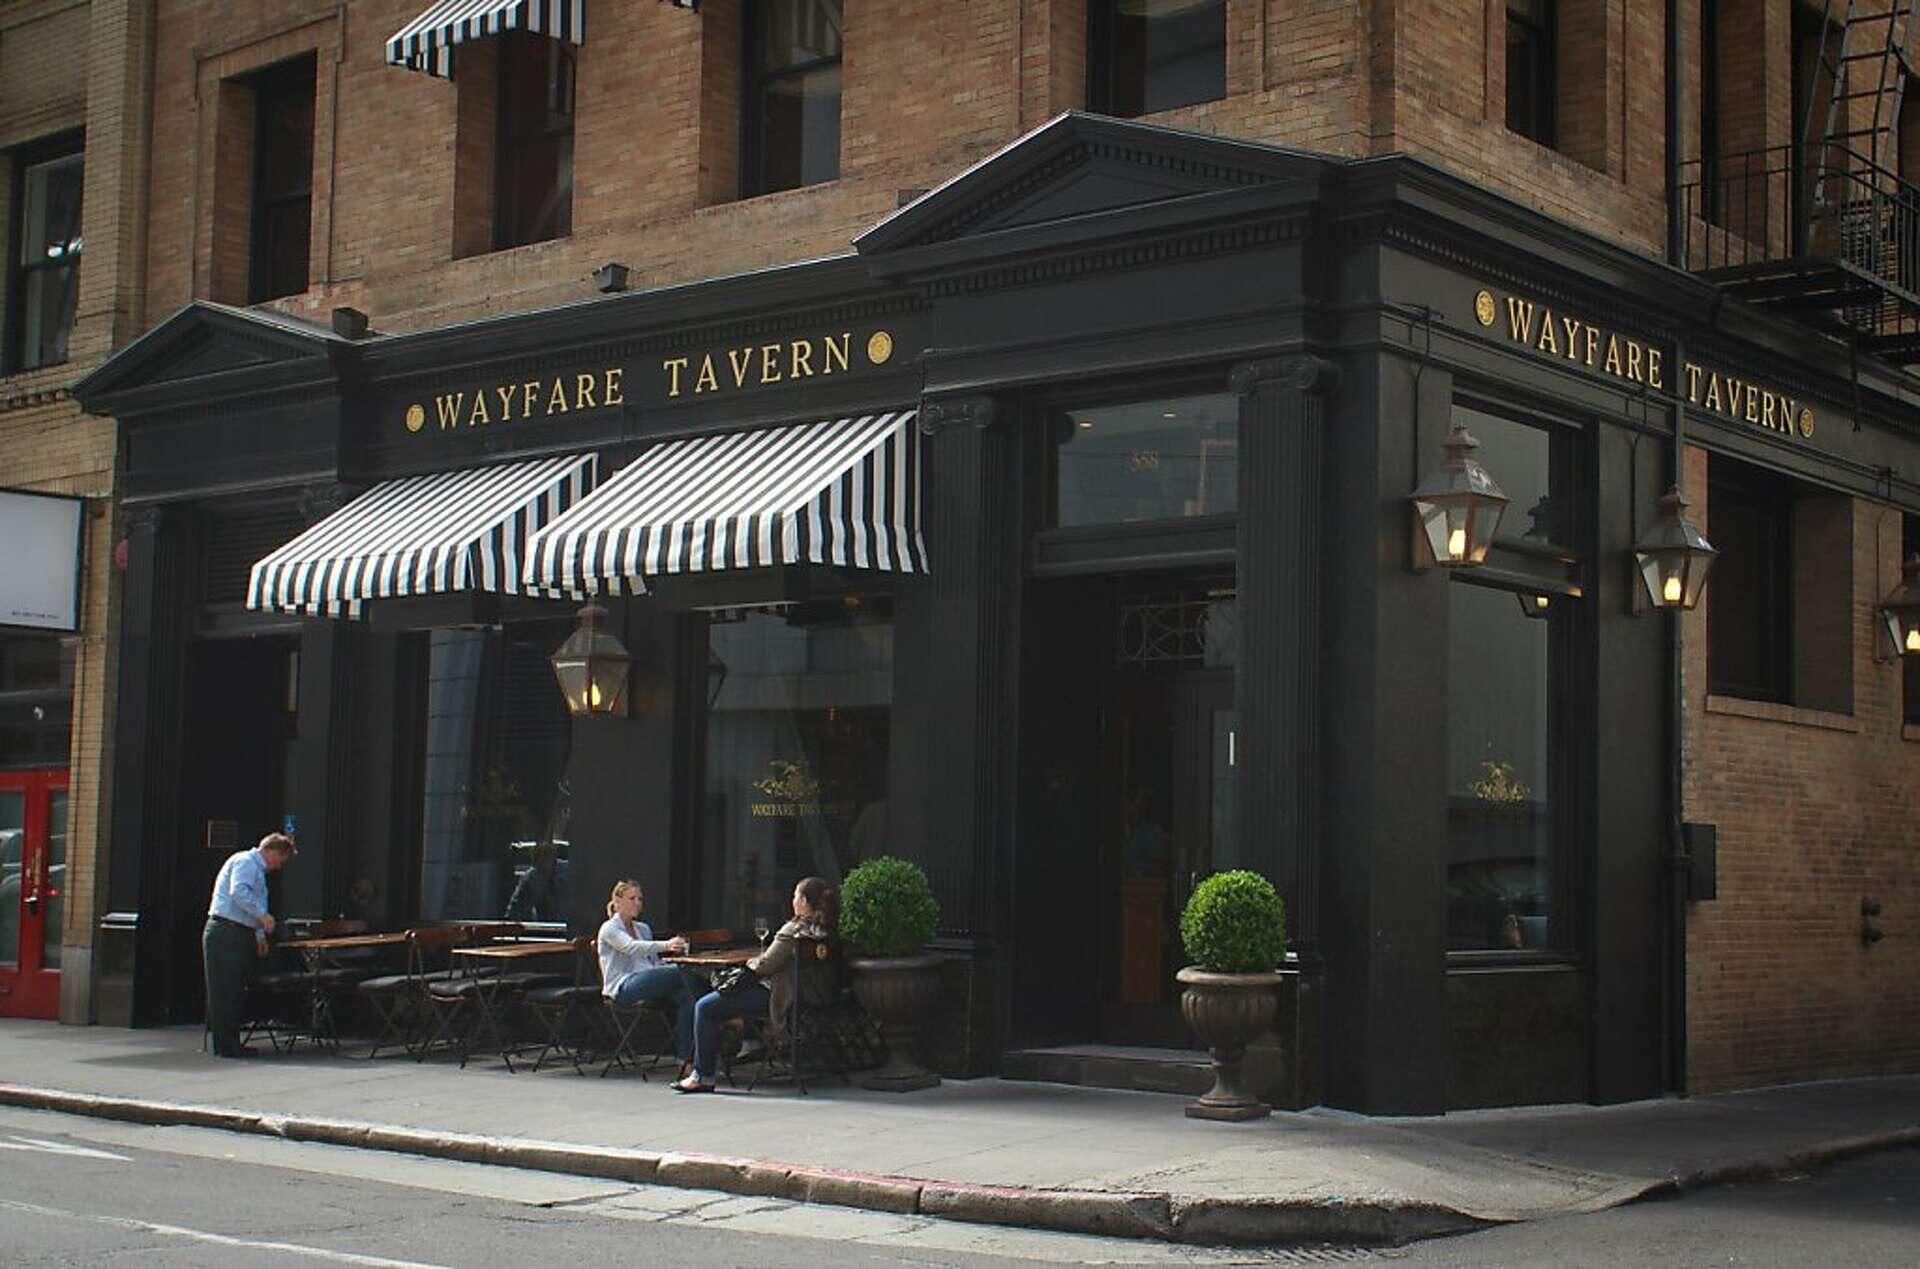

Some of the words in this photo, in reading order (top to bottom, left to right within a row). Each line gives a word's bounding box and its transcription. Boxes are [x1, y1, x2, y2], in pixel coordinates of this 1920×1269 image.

[436, 368, 624, 431] WAYFARE
[663, 332, 851, 397] TAVERN
[1507, 296, 1663, 391] WAYFARE
[1685, 362, 1796, 437] TAVERN
